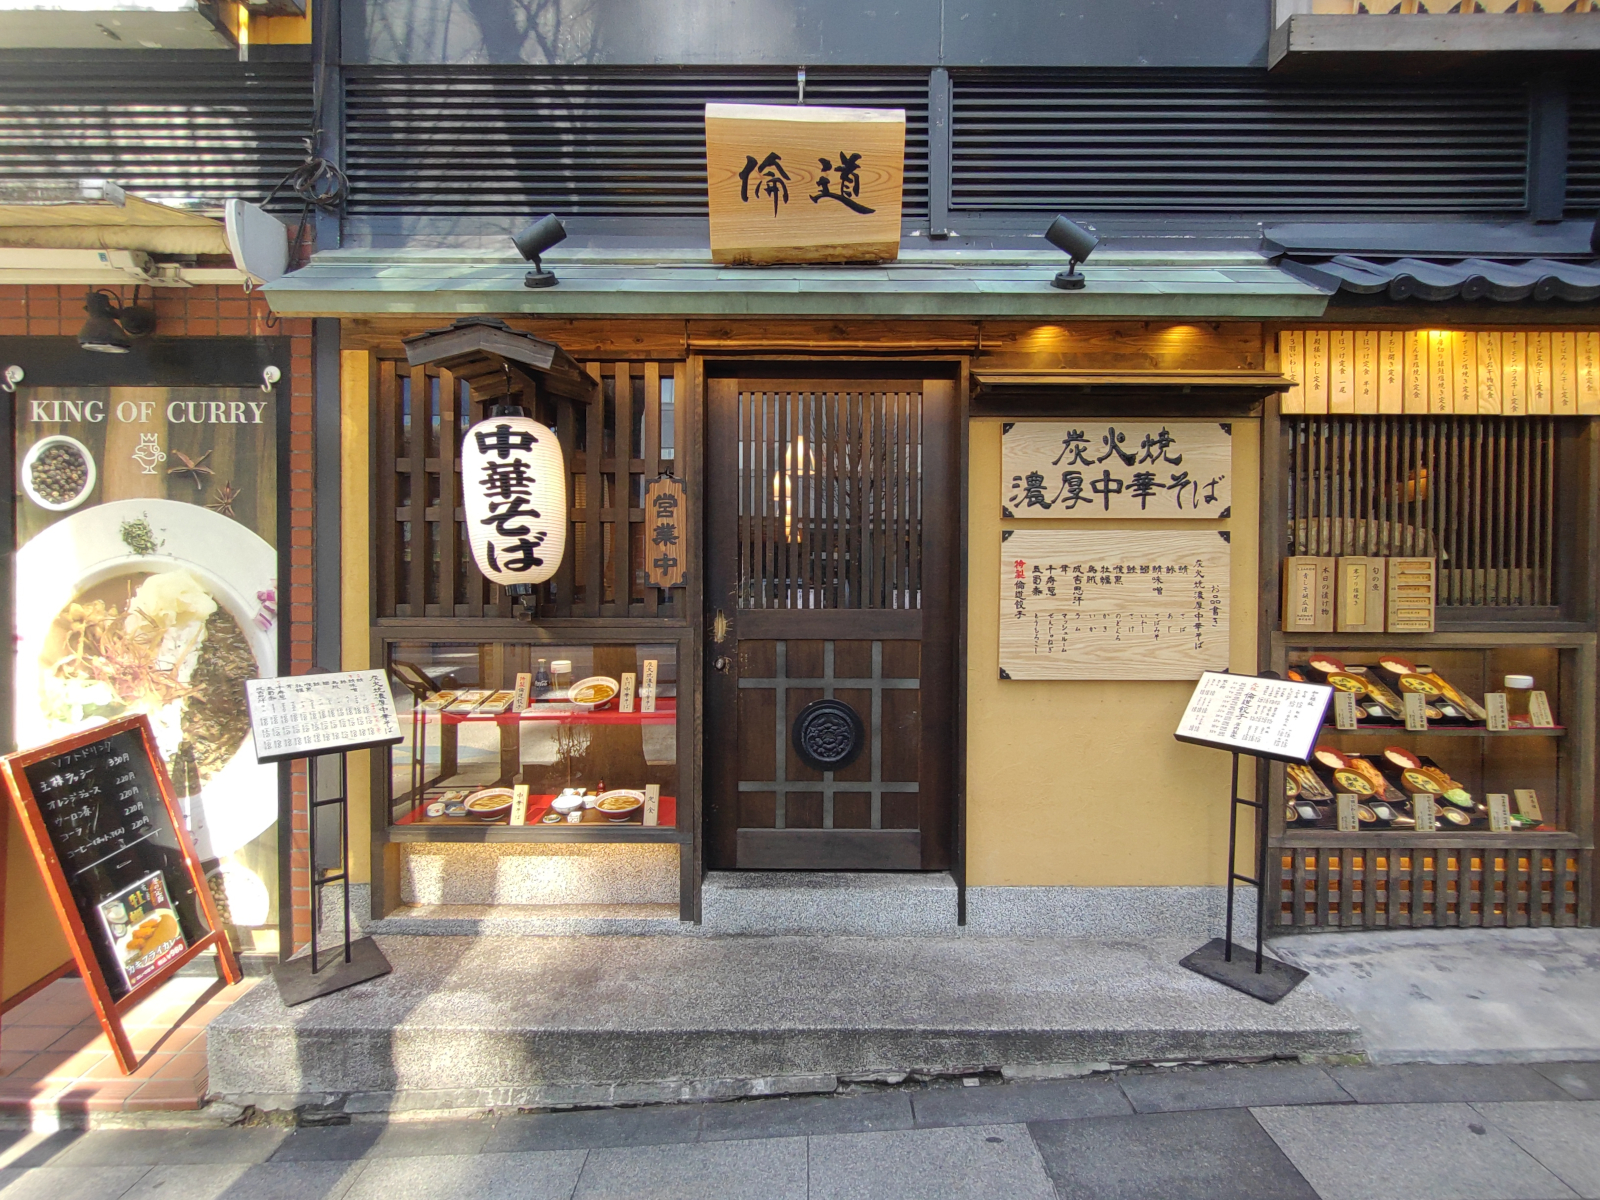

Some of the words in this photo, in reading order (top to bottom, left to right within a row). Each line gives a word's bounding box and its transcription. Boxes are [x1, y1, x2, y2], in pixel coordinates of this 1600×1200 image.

[739, 151, 876, 218] 倫道
[1338, 338, 1346, 375] ほっけ定食
[1387, 338, 1396, 384] あじ開き定食
[30, 400, 105, 423] KING
[116, 401, 156, 423] OF
[167, 401, 268, 424] CURRY
[1051, 426, 1182, 466] 炭火焼
[475, 424, 547, 573] 中華そば
[1009, 470, 1225, 511] 濃厚中華そば
[652, 493, 680, 576] 営業中
[1321, 566, 1330, 616] 本日の漬け物
[1372, 566, 1380, 591] 旬の魚
[1193, 559, 1205, 650] 炭火焼濃厚中華そば
[1209, 585, 1222, 627] お品書き
[51, 741, 111, 768] ソフトドリンク
[108, 752, 130, 767] 330円
[115, 771, 135, 785] 220円
[55, 805, 92, 826] ウーロン茶
[119, 786, 139, 800] 220円
[60, 827, 82, 841] コーラ
[124, 801, 144, 816] 220円
[131, 815, 149, 830] 220円
[127, 935, 181, 975] カキフライカレー
